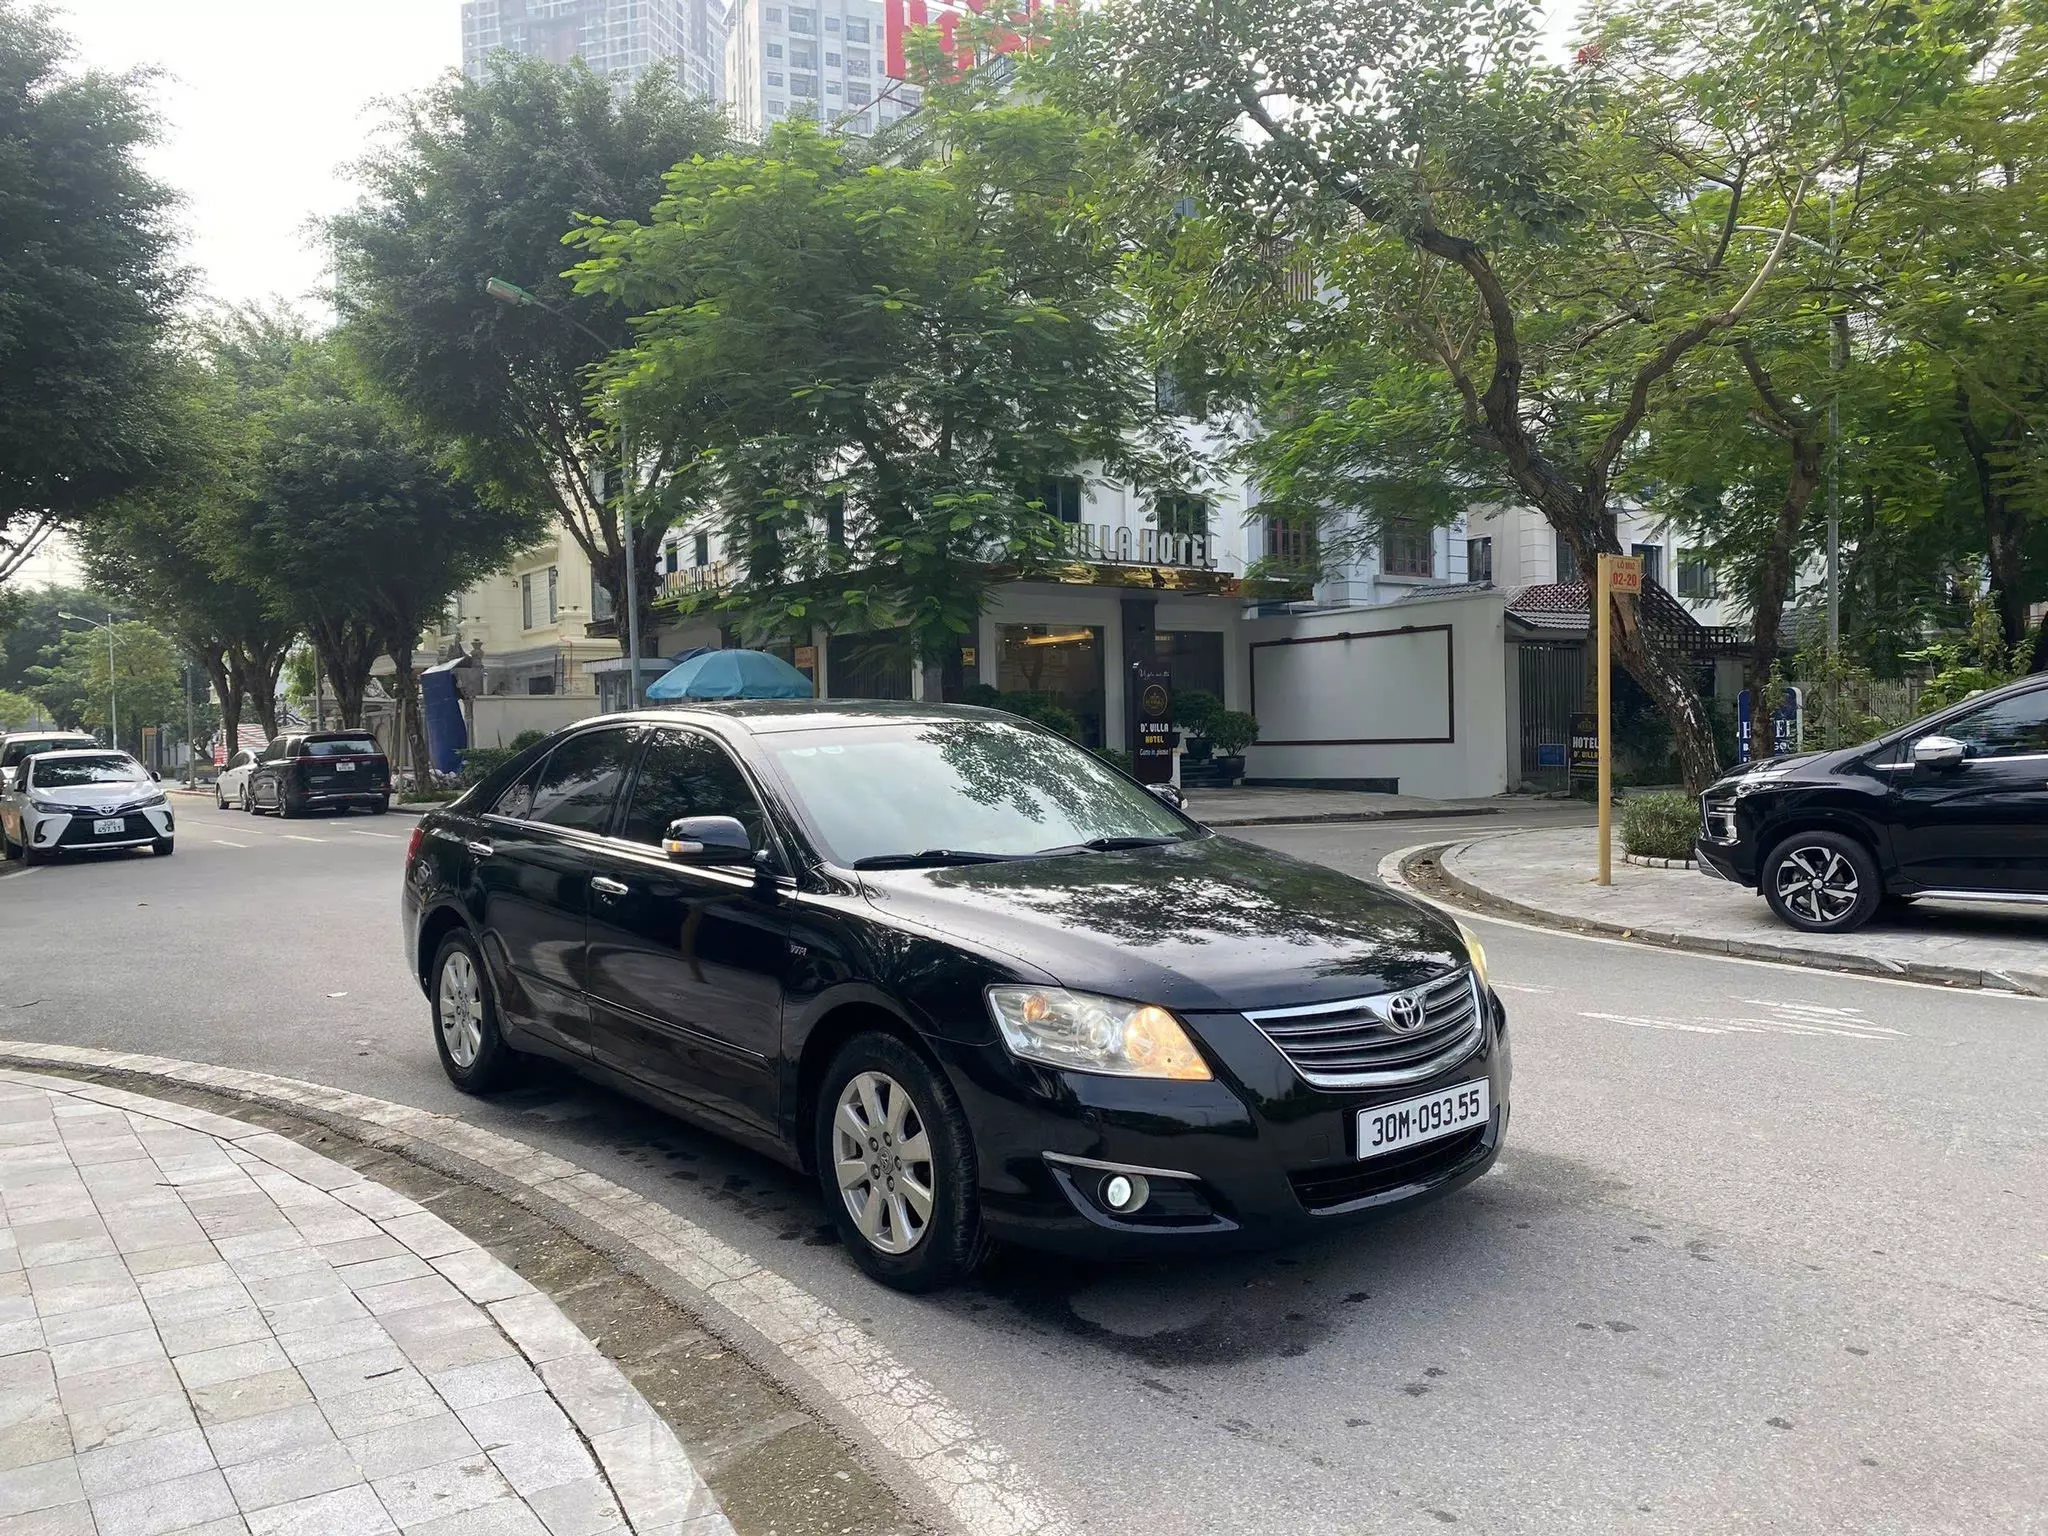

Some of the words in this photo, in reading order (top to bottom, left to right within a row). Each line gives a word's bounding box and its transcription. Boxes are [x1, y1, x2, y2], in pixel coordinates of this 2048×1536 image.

[1140, 528, 1218, 568] HOTEL
[1612, 571, 1638, 587] 02-20
[1742, 719, 1797, 739] HEL
[1145, 735, 1164, 744] HOTEL
[1572, 736, 1599, 749] HOTEL
